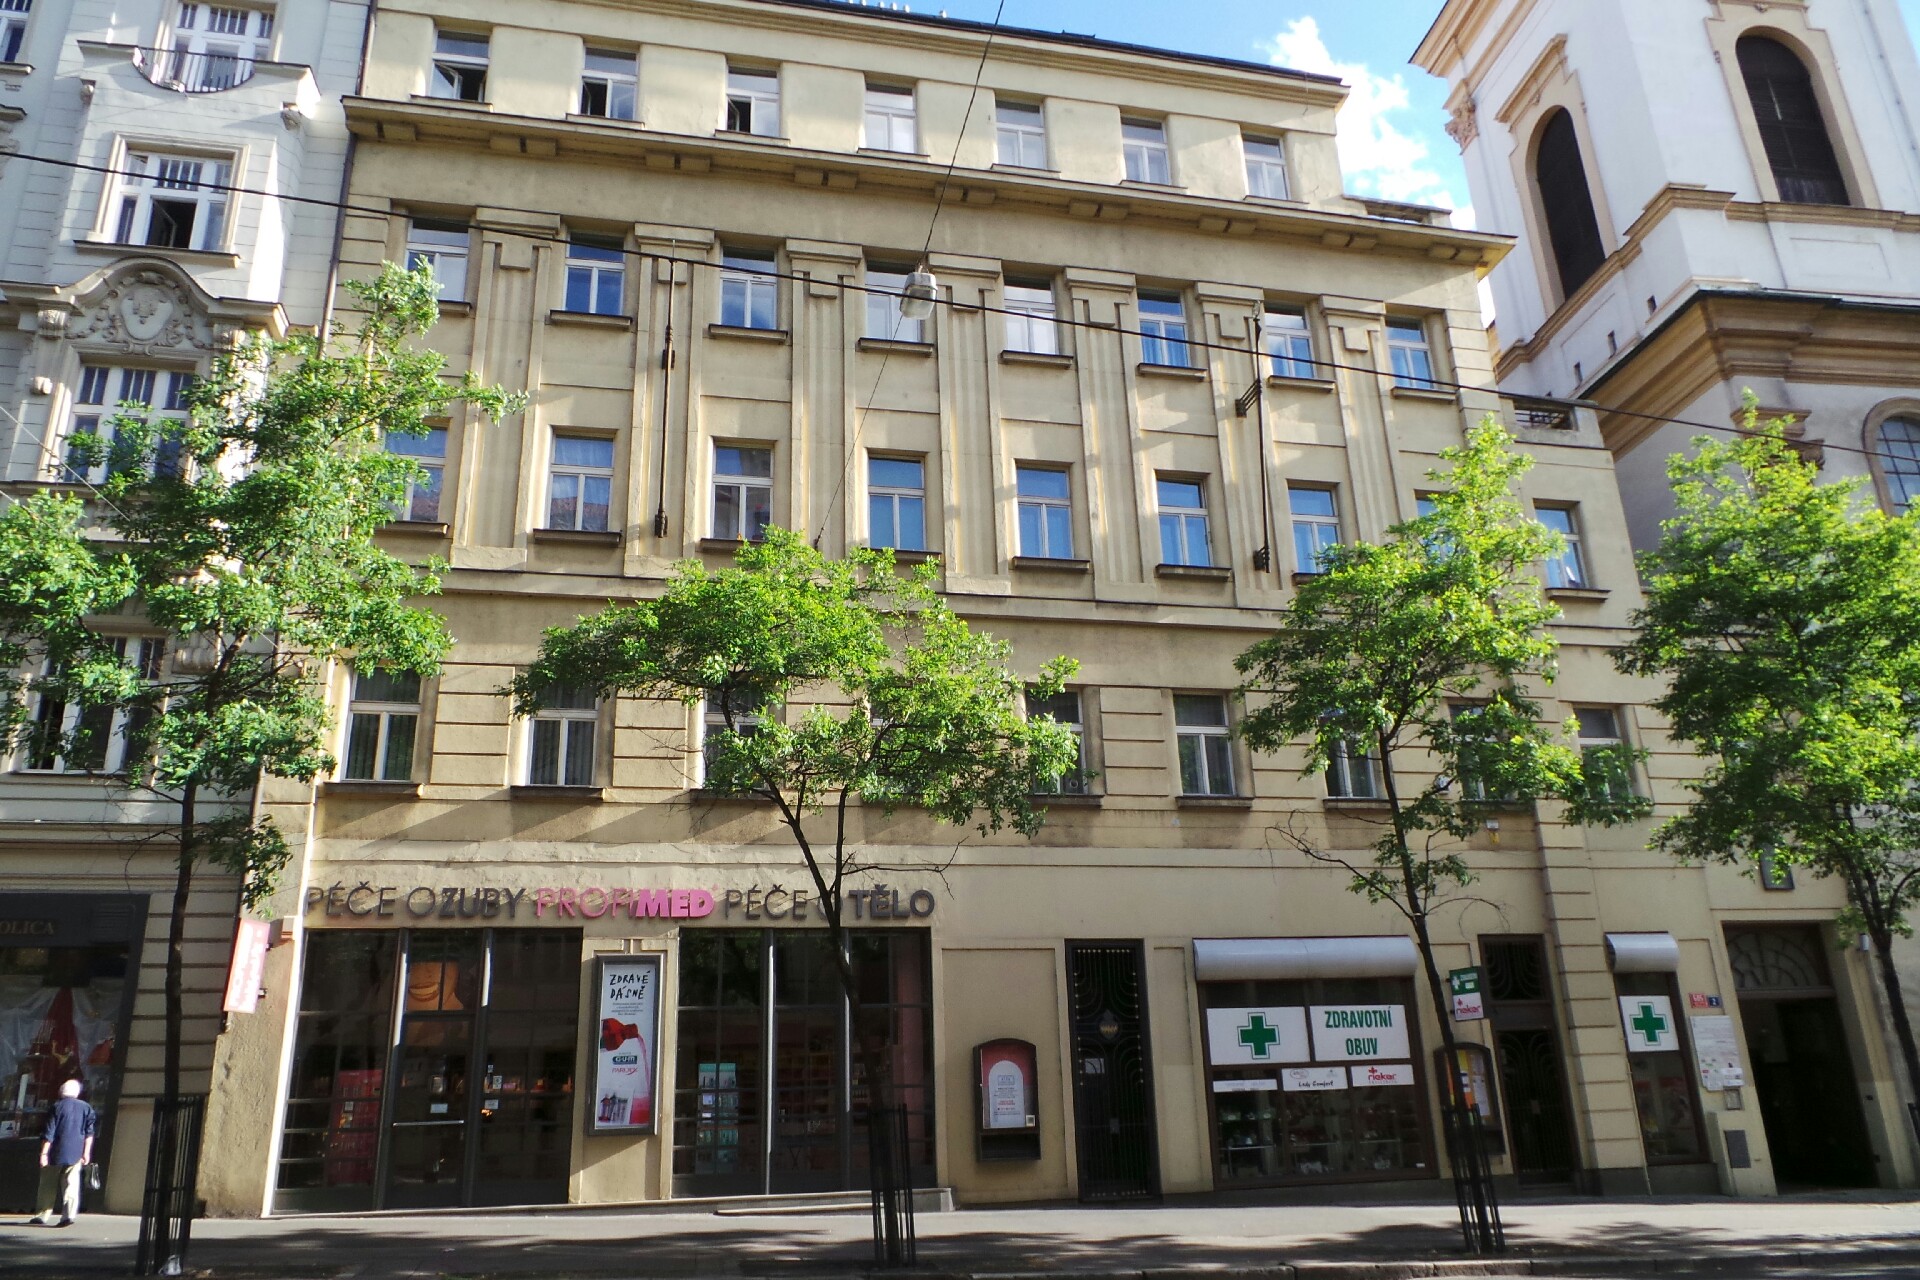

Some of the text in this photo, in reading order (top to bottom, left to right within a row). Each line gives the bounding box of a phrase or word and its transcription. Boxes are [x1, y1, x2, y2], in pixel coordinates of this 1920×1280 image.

[304, 881, 397, 917] PÉČE
[535, 887, 715, 918] PROFIMED
[724, 884, 809, 920] PÉČE
[849, 884, 935, 919] TĚLO
[609, 970, 651, 986] ZDRAVÉ
[610, 985, 646, 1001] DÁSNĚ
[1324, 1006, 1392, 1028] ZDRAVOTNÍ
[1345, 1038, 1378, 1056] OBUV
[1368, 1072, 1397, 1081] rieker
